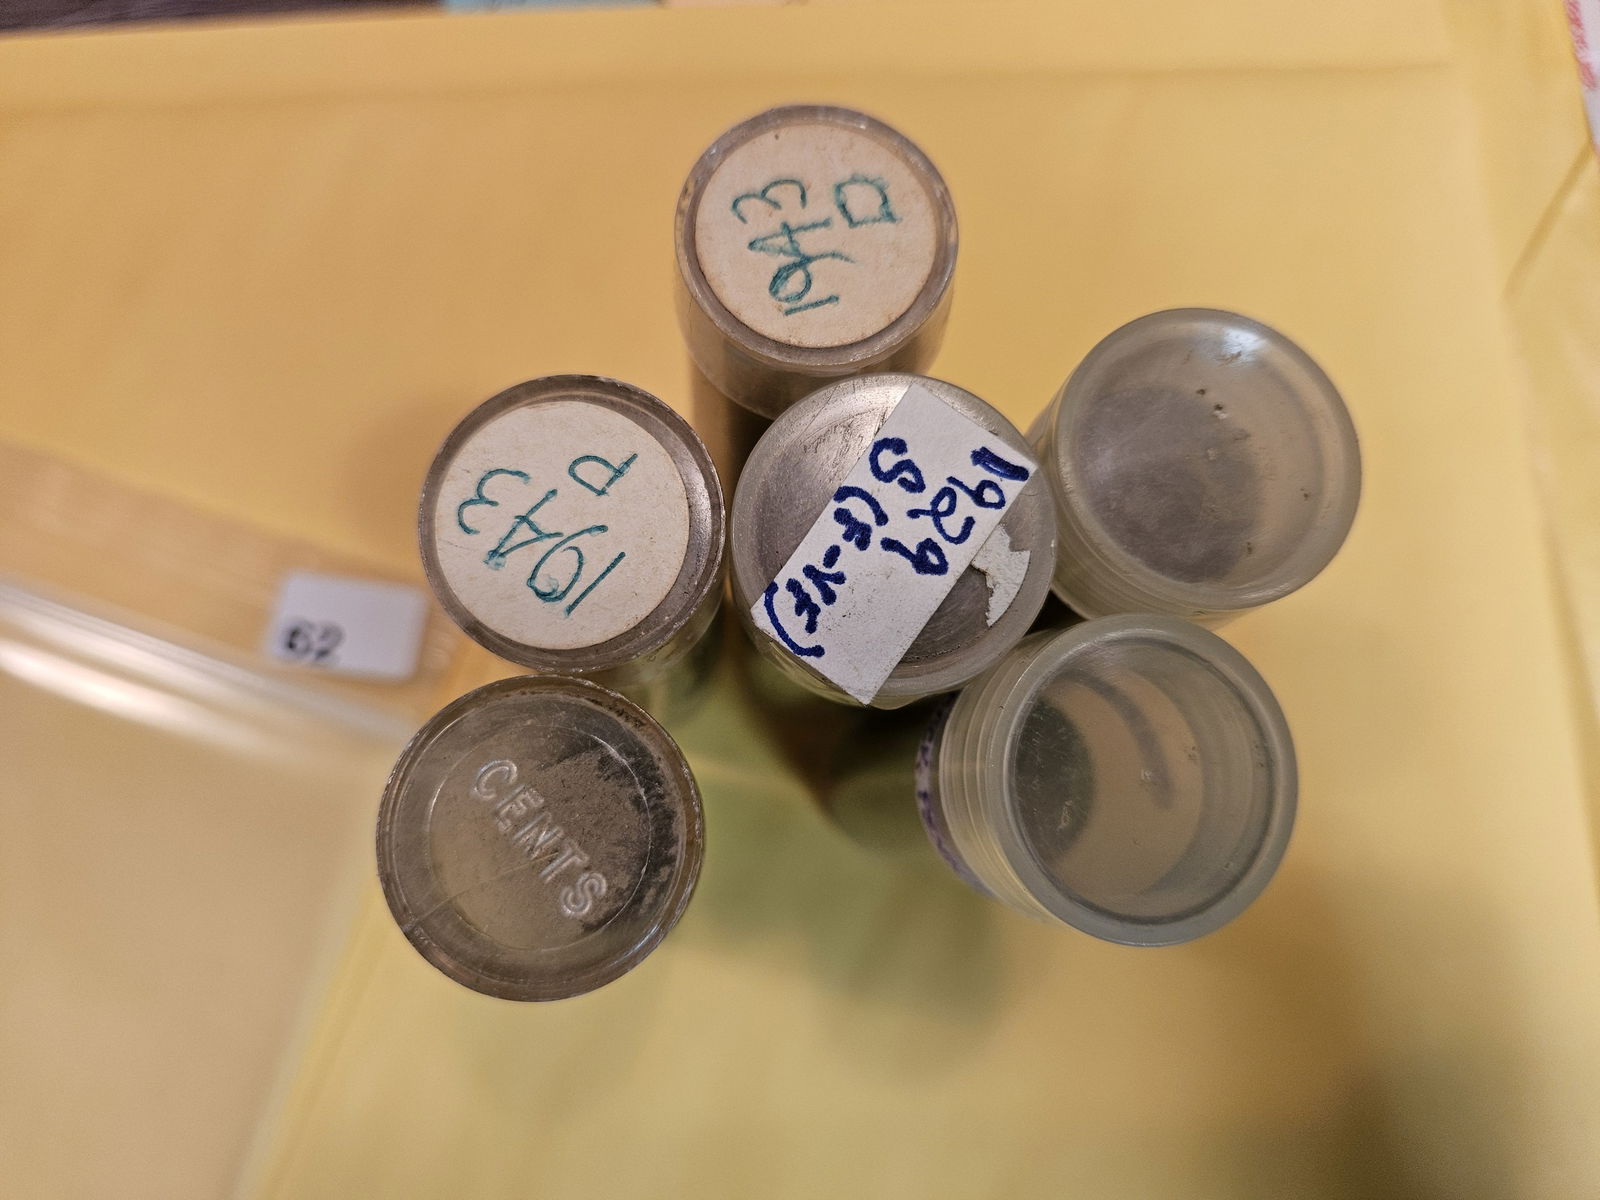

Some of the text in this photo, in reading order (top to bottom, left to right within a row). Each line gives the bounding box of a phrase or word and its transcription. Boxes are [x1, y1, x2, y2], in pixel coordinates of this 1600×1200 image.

[732, 178, 856, 316] 1943
[834, 173, 902, 228] D
[869, 437, 926, 493] S
[880, 446, 1029, 576] 1929
[457, 467, 626, 619] 1943
[473, 759, 607, 917] CENTS
